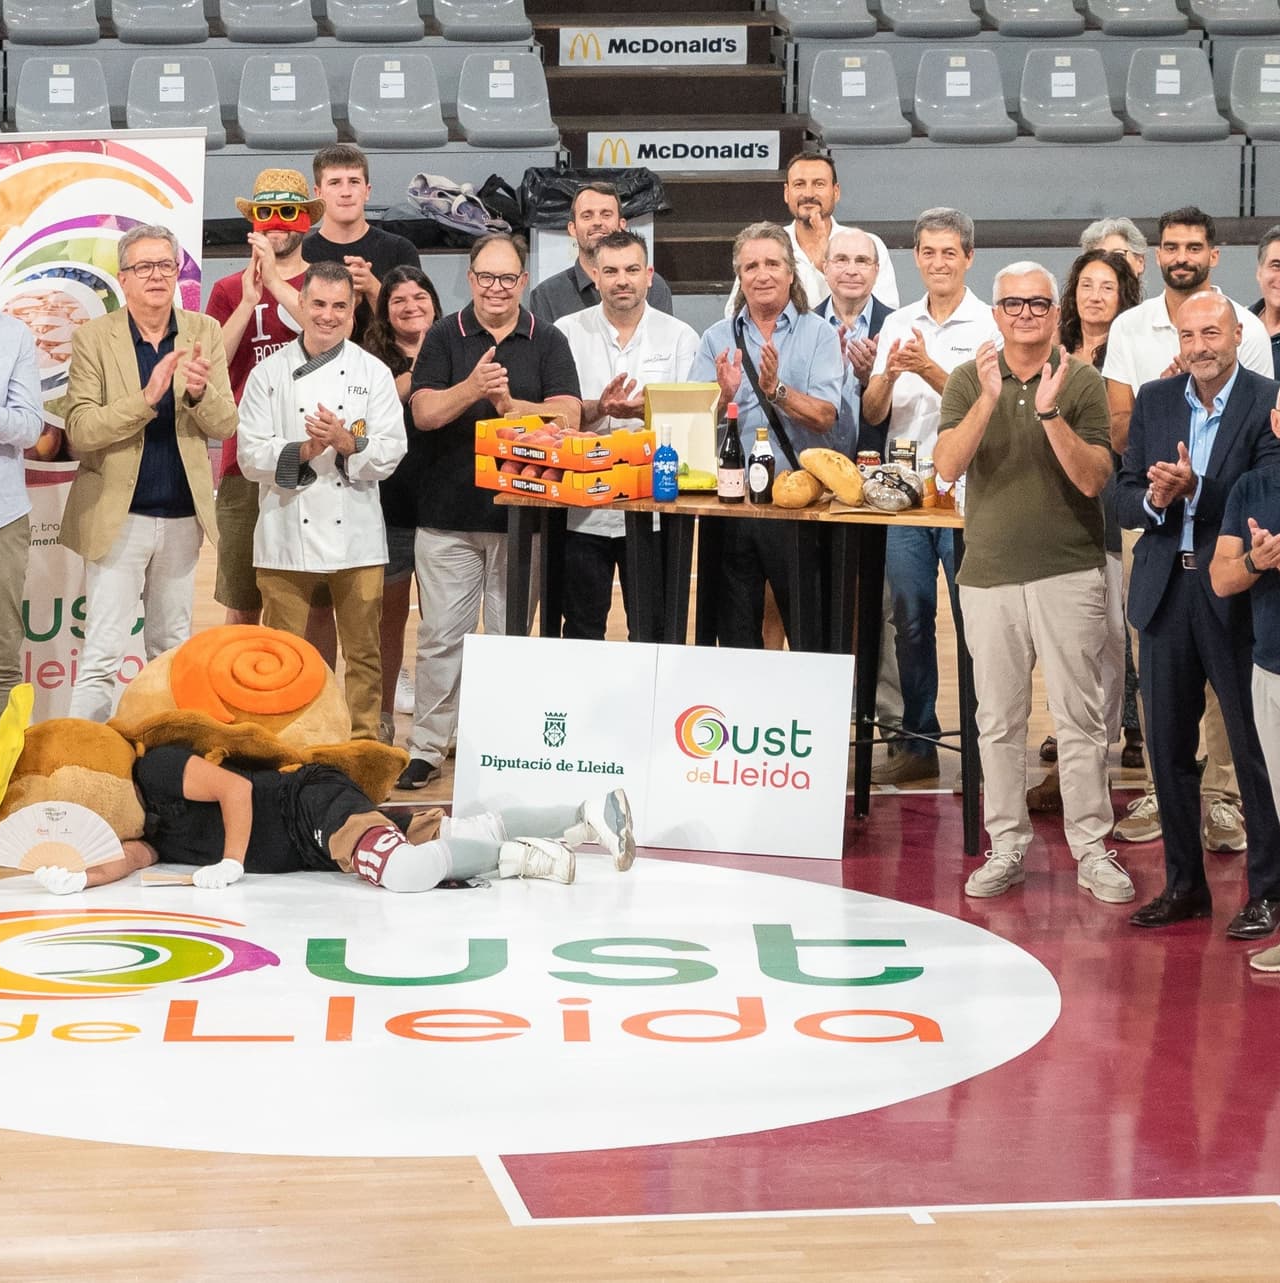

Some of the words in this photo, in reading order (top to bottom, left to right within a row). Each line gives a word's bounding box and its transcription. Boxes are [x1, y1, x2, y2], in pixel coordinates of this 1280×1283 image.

[608, 37, 737, 54] McDonald's
[637, 143, 769, 159] McDonald's
[480, 754, 552, 773] Diputació
[556, 759, 574, 772] de
[577, 760, 625, 775] Lleida
